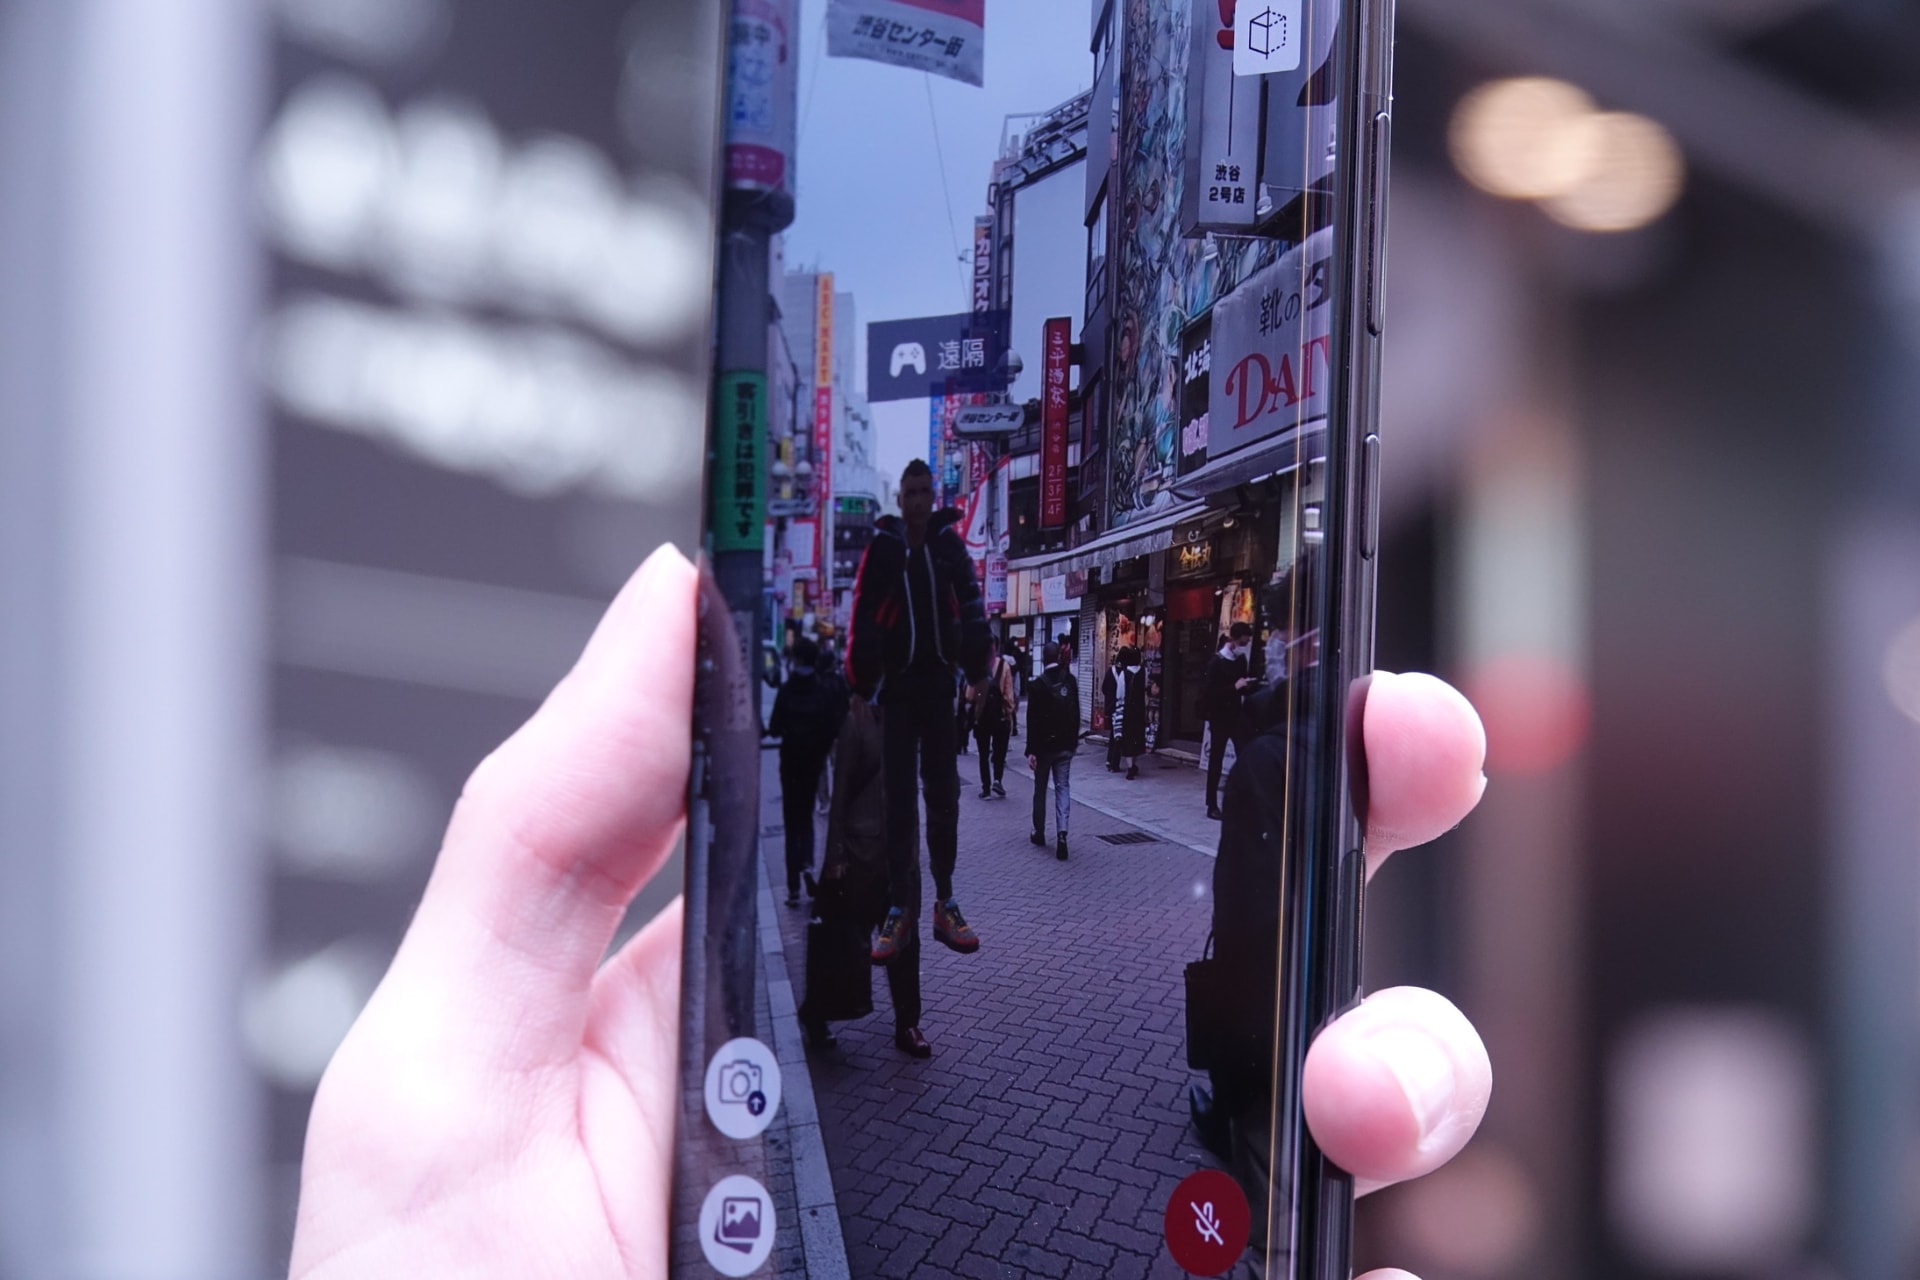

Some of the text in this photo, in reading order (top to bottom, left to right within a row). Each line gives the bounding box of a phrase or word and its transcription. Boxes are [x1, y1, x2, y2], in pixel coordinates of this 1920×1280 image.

[852, 13, 965, 58] 渋谷センター街
[1214, 164, 1241, 182] 渋谷
[1209, 186, 1246, 205] 2号店
[975, 238, 991, 312] カラオケ
[937, 338, 985, 370] 遠隔
[1048, 465, 1063, 478] 2F
[1048, 484, 1062, 496] 3F
[1047, 503, 1062, 515] 4F
